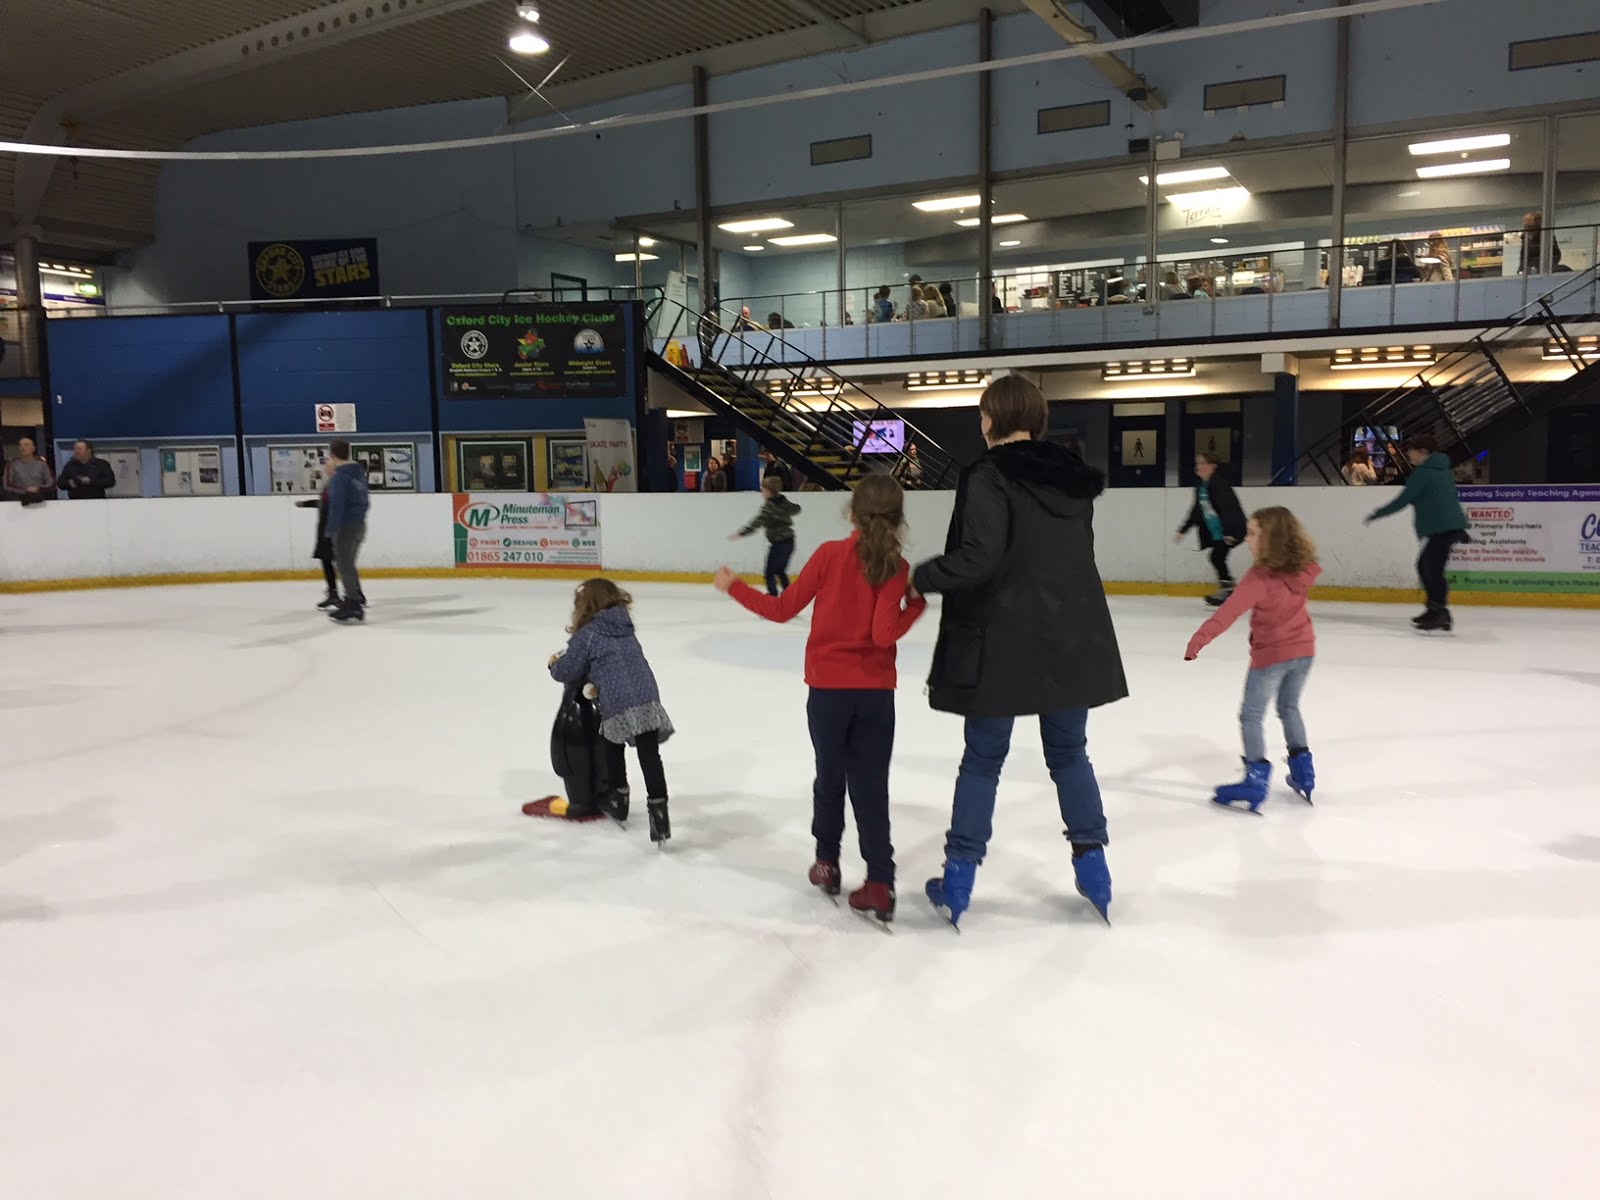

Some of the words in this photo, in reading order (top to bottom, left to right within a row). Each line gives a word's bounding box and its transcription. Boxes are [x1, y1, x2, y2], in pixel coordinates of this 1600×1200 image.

[314, 262, 371, 287] STARS
[447, 315, 485, 326] Oxford
[488, 314, 511, 327] City
[514, 314, 532, 325] Ice
[536, 313, 579, 326] Hockey
[582, 313, 616, 323] Clubs
[589, 440, 607, 449] SKATE
[608, 440, 628, 448] PARTY
[1457, 490, 1493, 498] Leading
[1495, 489, 1525, 498] Supply
[1527, 489, 1569, 498] Teaching
[1572, 489, 1600, 498] Agenc
[502, 504, 560, 514] Minuteman
[1470, 510, 1511, 519] WANTED
[500, 515, 528, 524] Press
[1474, 523, 1504, 531] Primary
[468, 551, 500, 560] 01865
[503, 551, 522, 561] 247
[524, 551, 544, 561] 010
